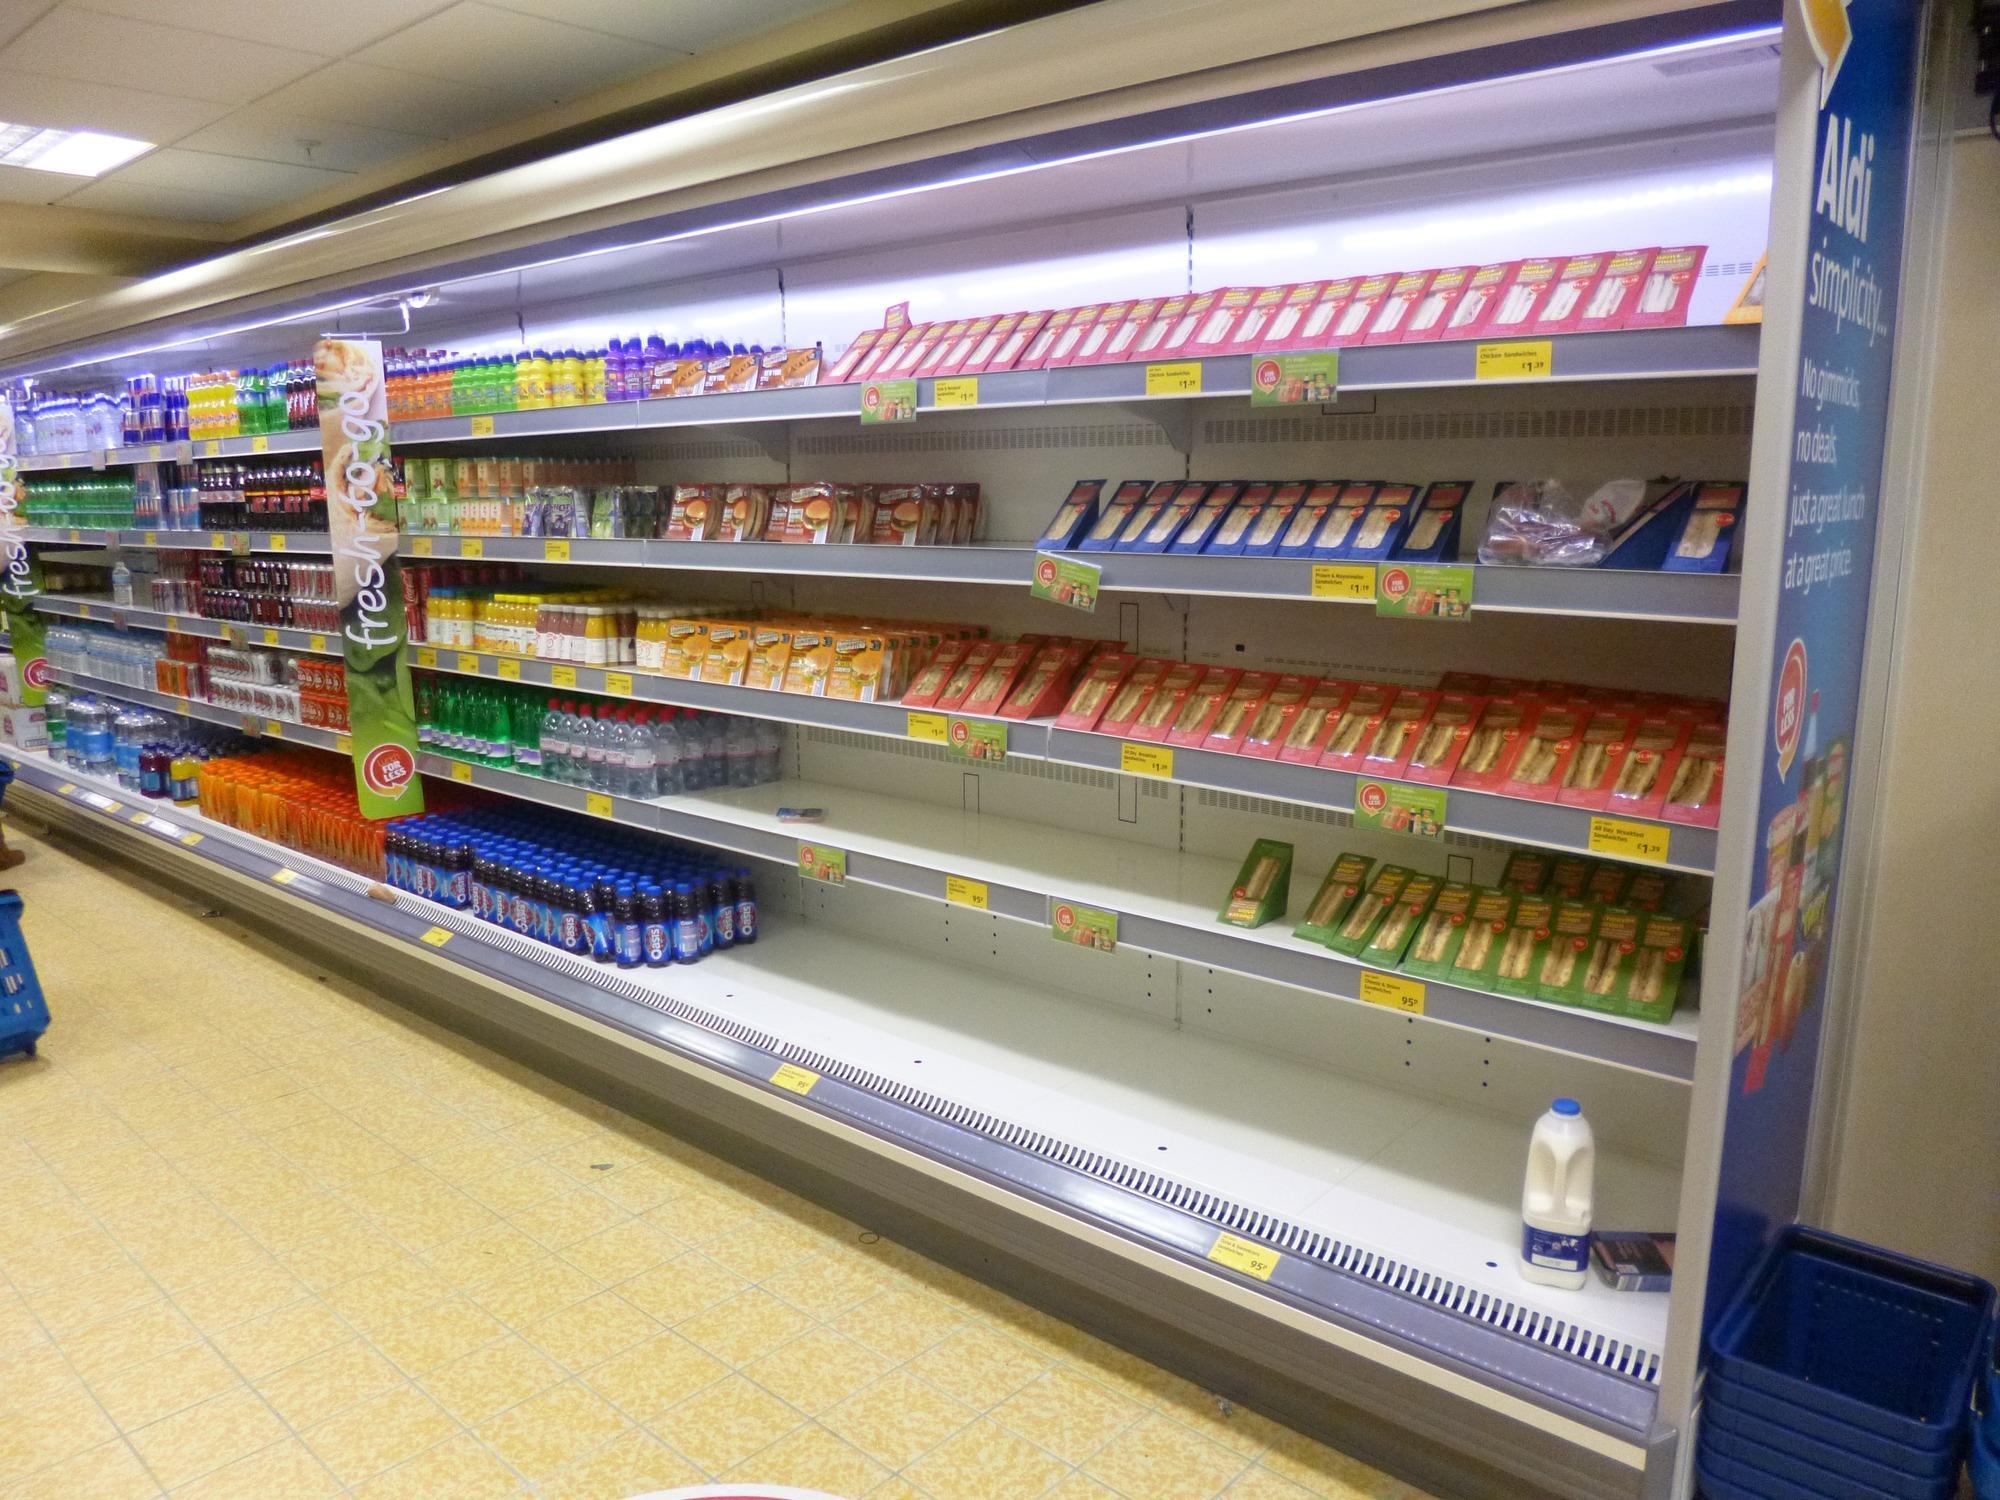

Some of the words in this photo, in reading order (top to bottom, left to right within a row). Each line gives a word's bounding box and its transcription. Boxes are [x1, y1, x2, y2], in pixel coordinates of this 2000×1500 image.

[1816, 112, 1875, 244] Aldi
[1809, 236, 1887, 347] simplicity...
[1504, 350, 1537, 358] Sandwiches
[1803, 358, 1816, 398] No
[1796, 431, 1811, 463] no
[340, 390, 398, 650] fresh-to-go
[1789, 484, 1810, 537] just
[1810, 496, 1817, 523] a
[1817, 490, 1841, 533] great
[1842, 485, 1865, 521] lunch
[1785, 552, 1797, 590] at
[1804, 548, 1828, 595] great
[382, 760, 402, 773] FOR
[383, 767, 407, 782] LESS
[1594, 832, 1628, 842] Sandwiches
[566, 917, 577, 947] Oasis
[724, 909, 733, 940] Oasis
[742, 905, 752, 935] Oasis
[651, 929, 662, 960] Oasis
